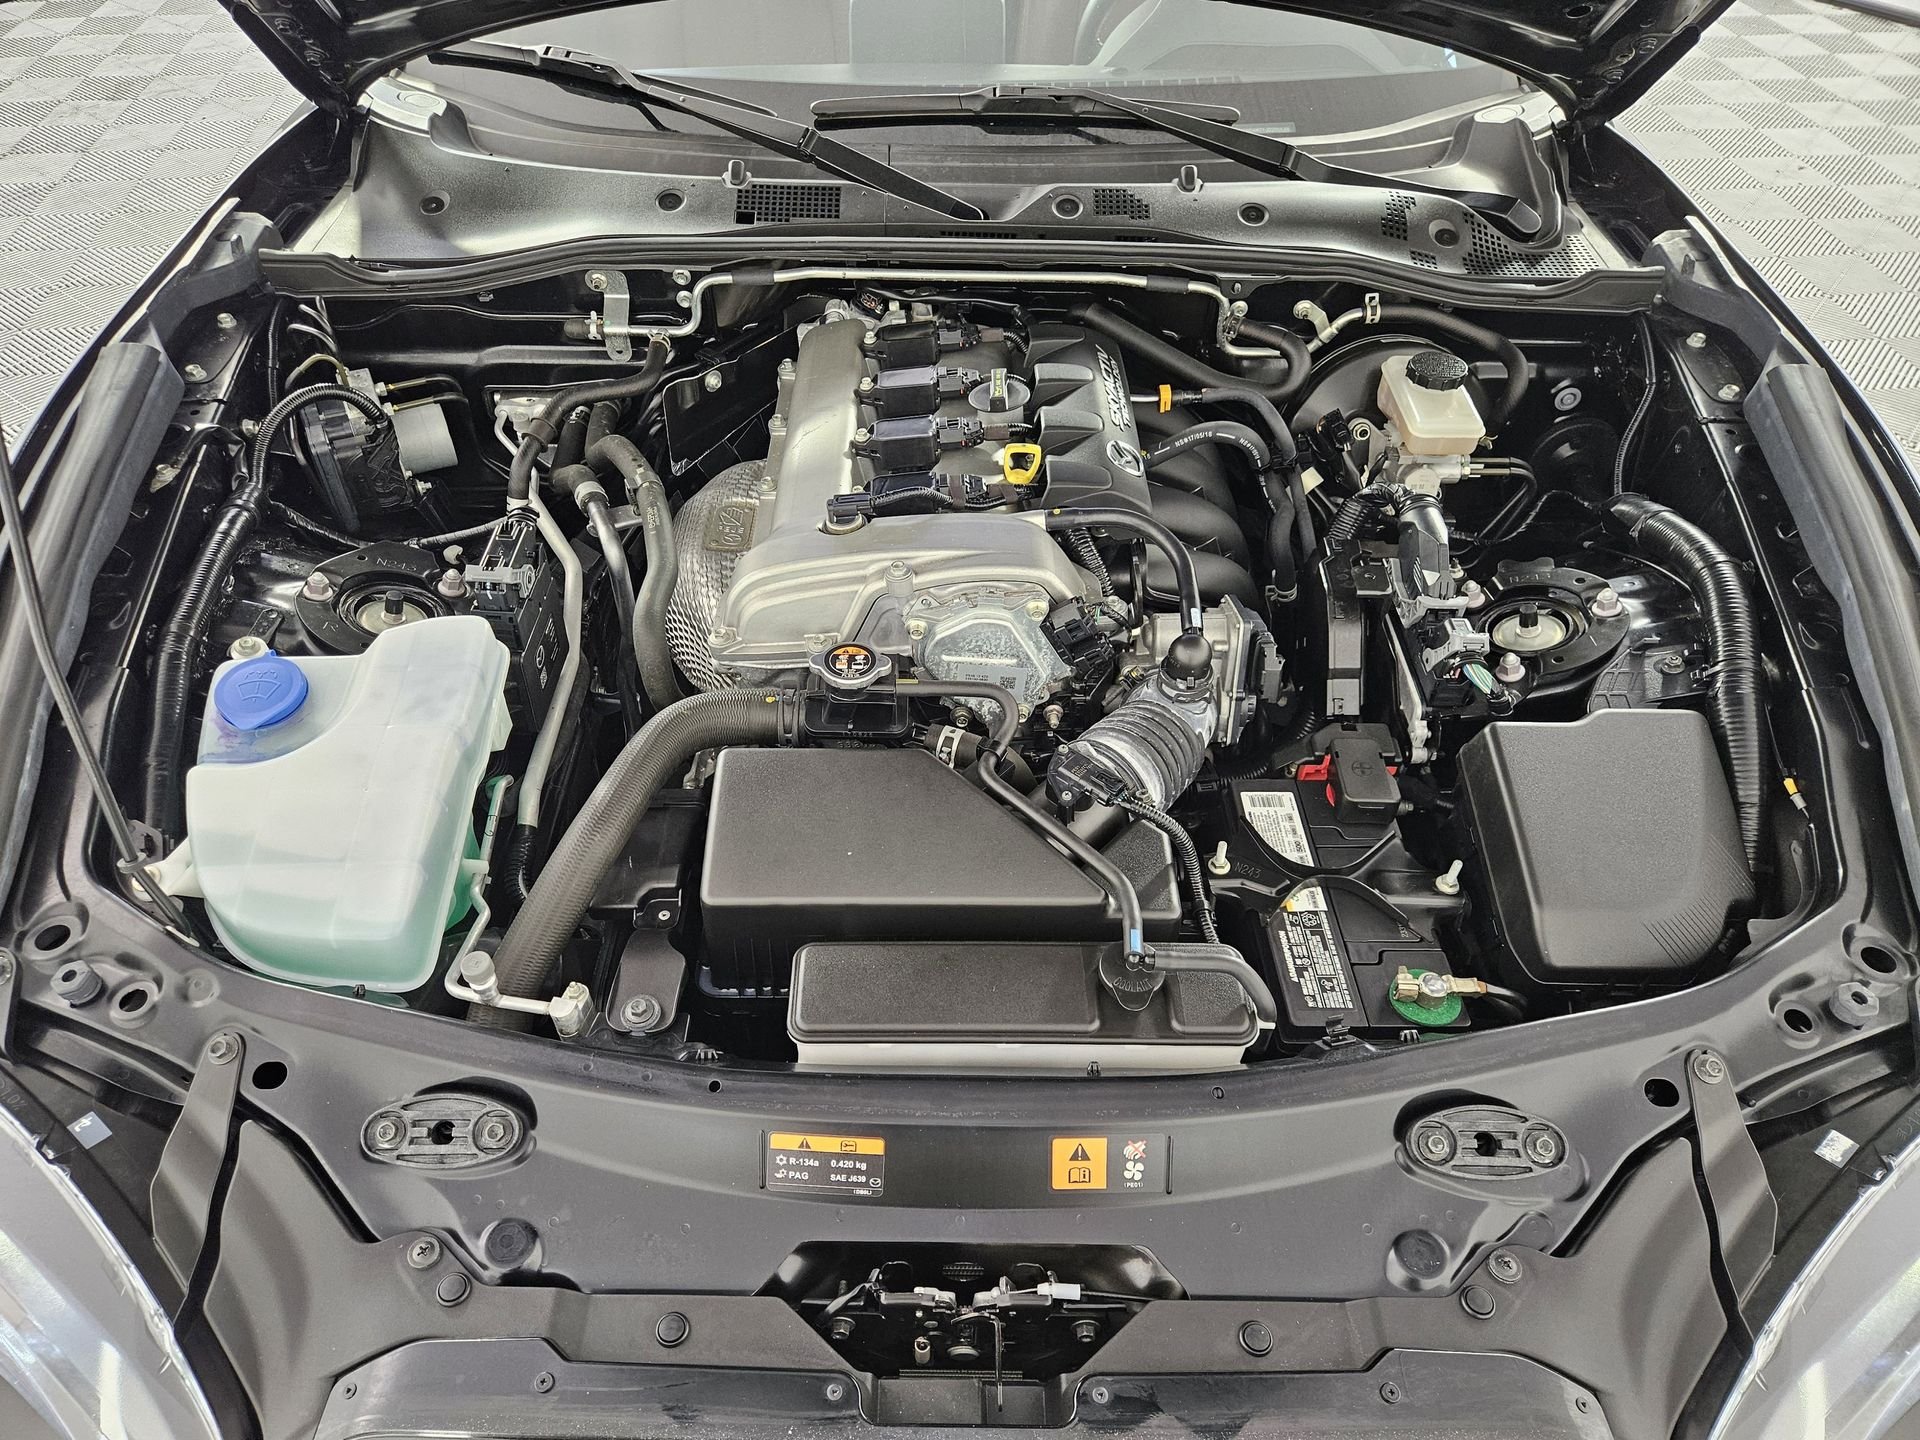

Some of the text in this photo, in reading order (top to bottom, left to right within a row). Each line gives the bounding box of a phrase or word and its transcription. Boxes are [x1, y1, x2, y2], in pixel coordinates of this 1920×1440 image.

[1095, 344, 1124, 432] SKYACTIV
[1113, 976, 1153, 992] COOLANT
[789, 1157, 867, 1171] R-134a 0.420 kg
[788, 1170, 866, 1183] PAG SAE J639
